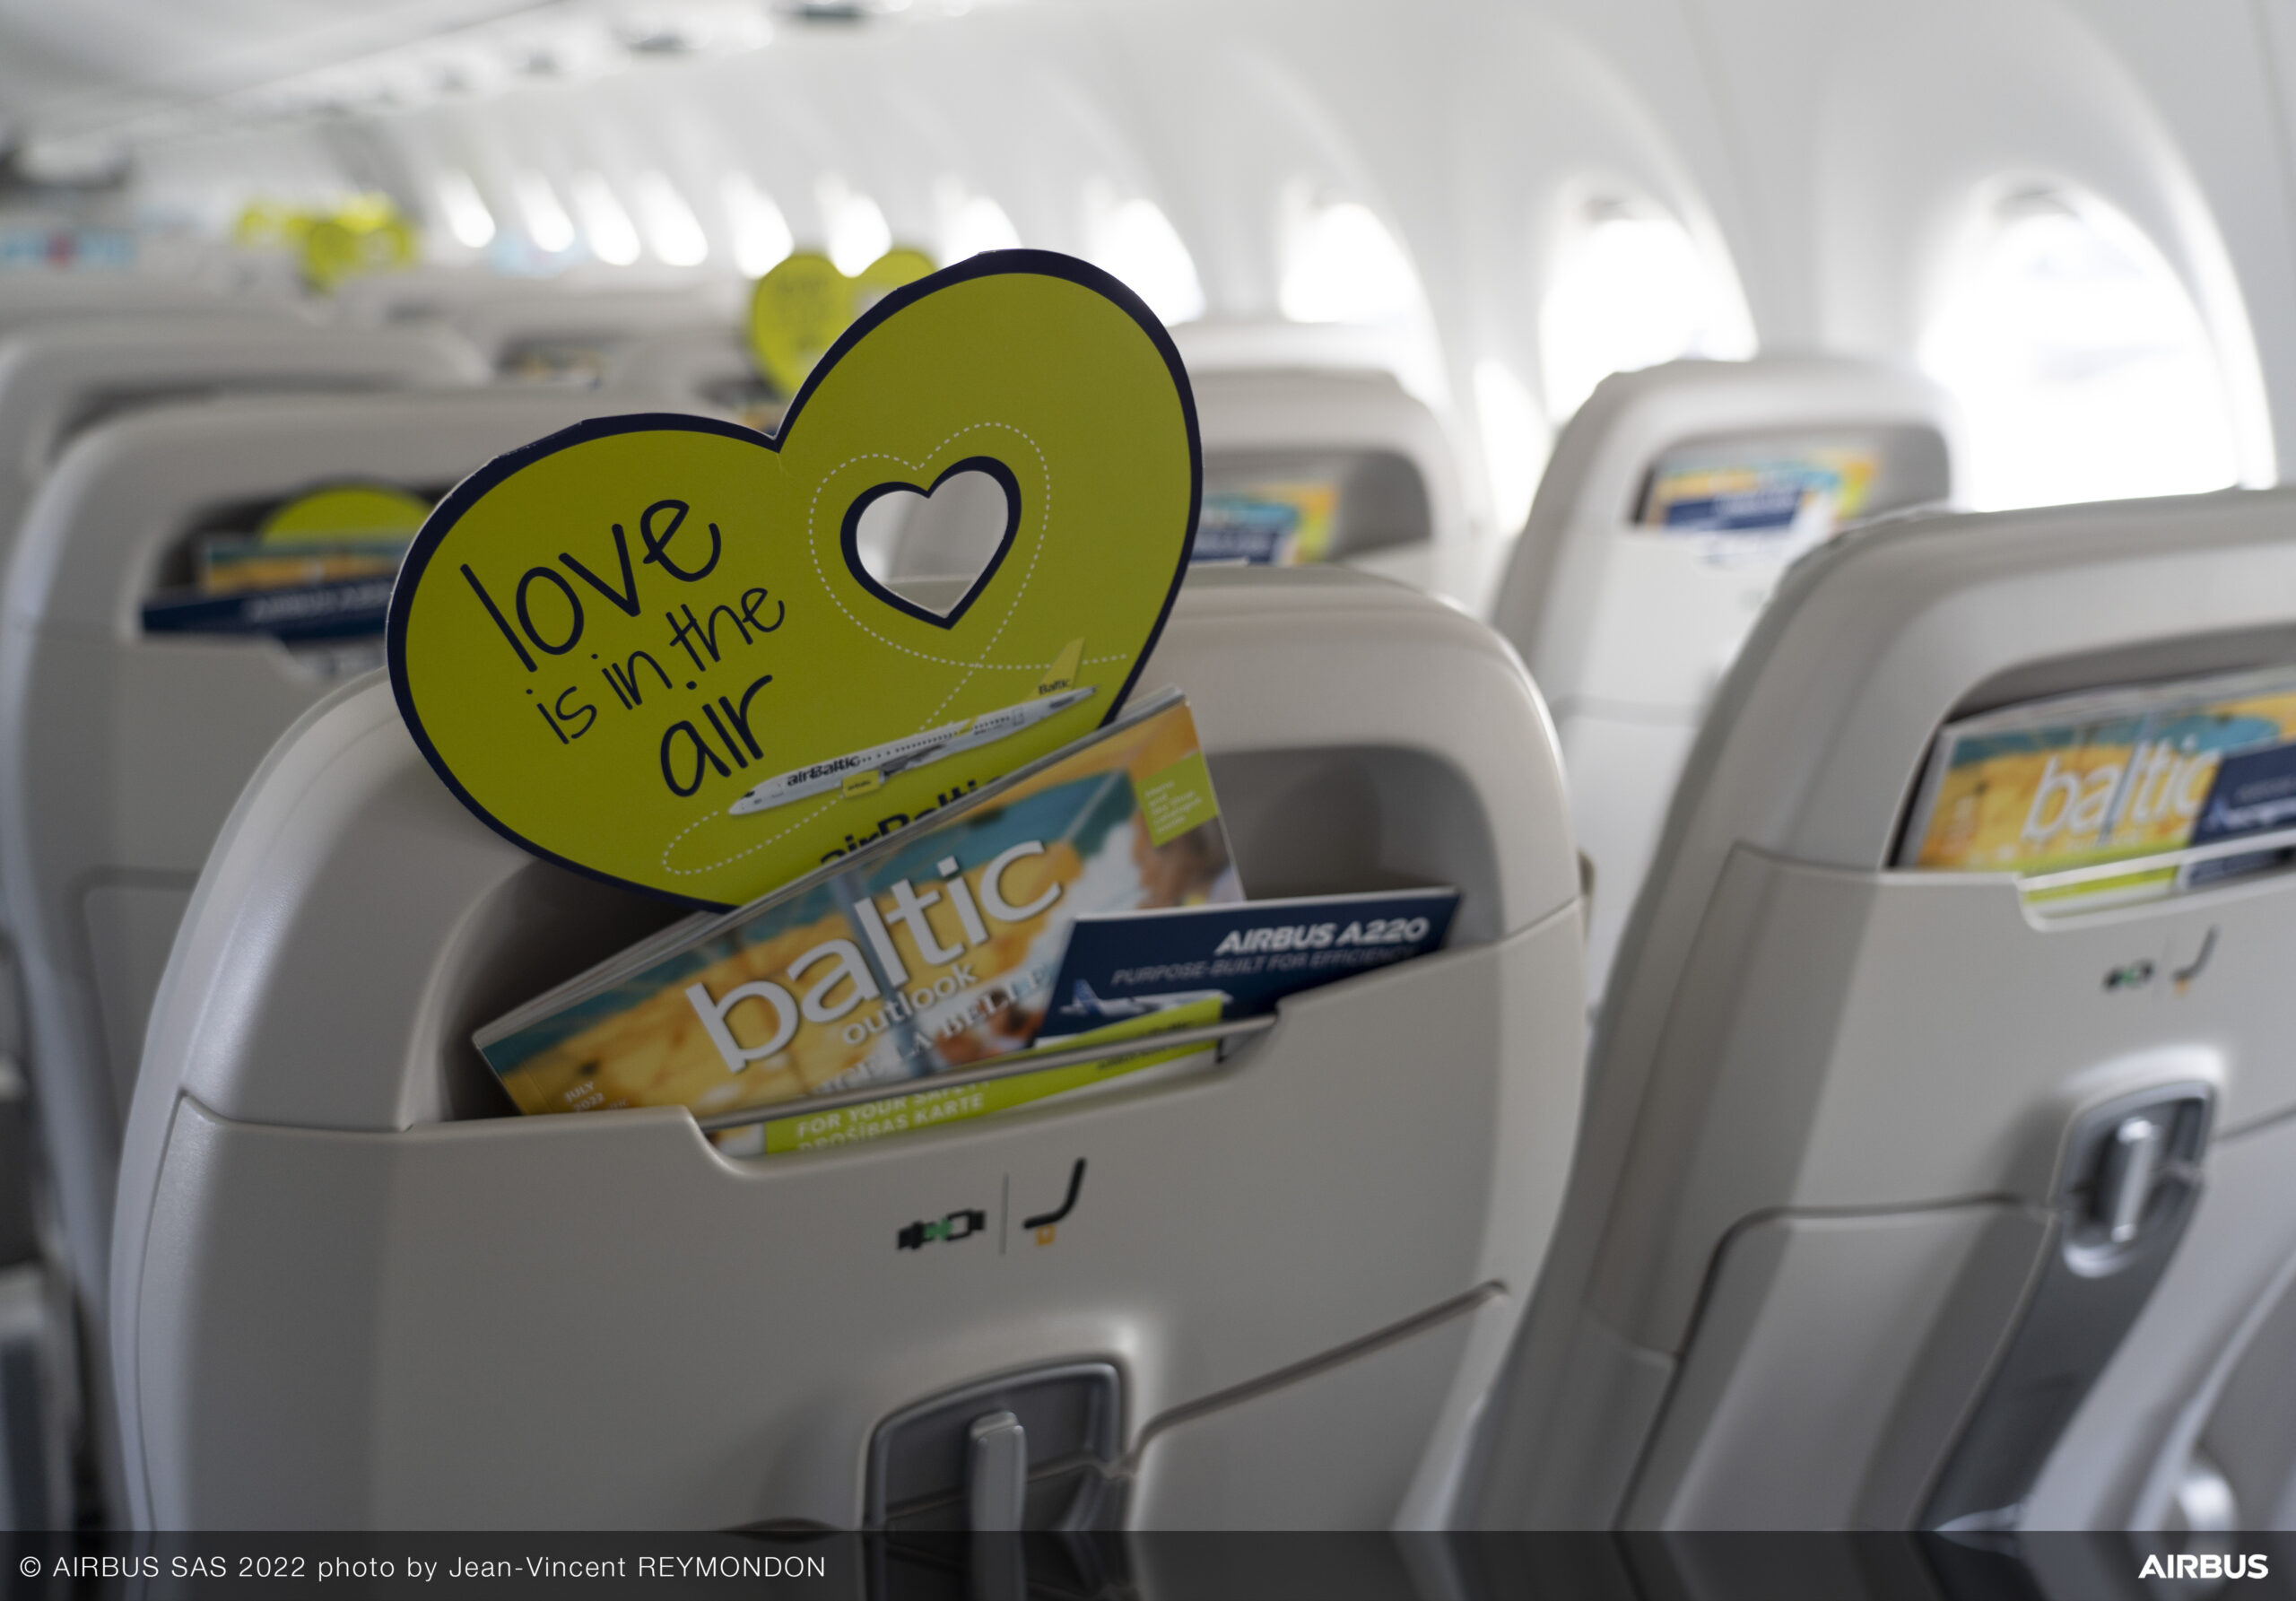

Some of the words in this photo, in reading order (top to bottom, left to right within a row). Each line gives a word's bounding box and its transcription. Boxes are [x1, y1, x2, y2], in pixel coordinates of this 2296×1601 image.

[459, 499, 722, 673] love
[526, 685, 598, 745] is
[591, 650, 673, 711] in
[665, 587, 786, 673] the
[660, 674, 773, 797] air
[787, 755, 862, 787] airBaltic
[2022, 733, 2221, 840] baltic
[685, 840, 1063, 1075] baltic
[1214, 921, 1335, 956] AIRBUS
[1335, 917, 1431, 947] A220
[1111, 956, 1265, 988] PURPOSE-BUILT
[1268, 953, 1308, 971] FOR
[840, 963, 979, 1047] outlook
[564, 1081, 595, 1103] JULY
[797, 1113, 841, 1139] FOR
[848, 1097, 907, 1123] YOUR
[914, 1092, 985, 1125] KARTE
